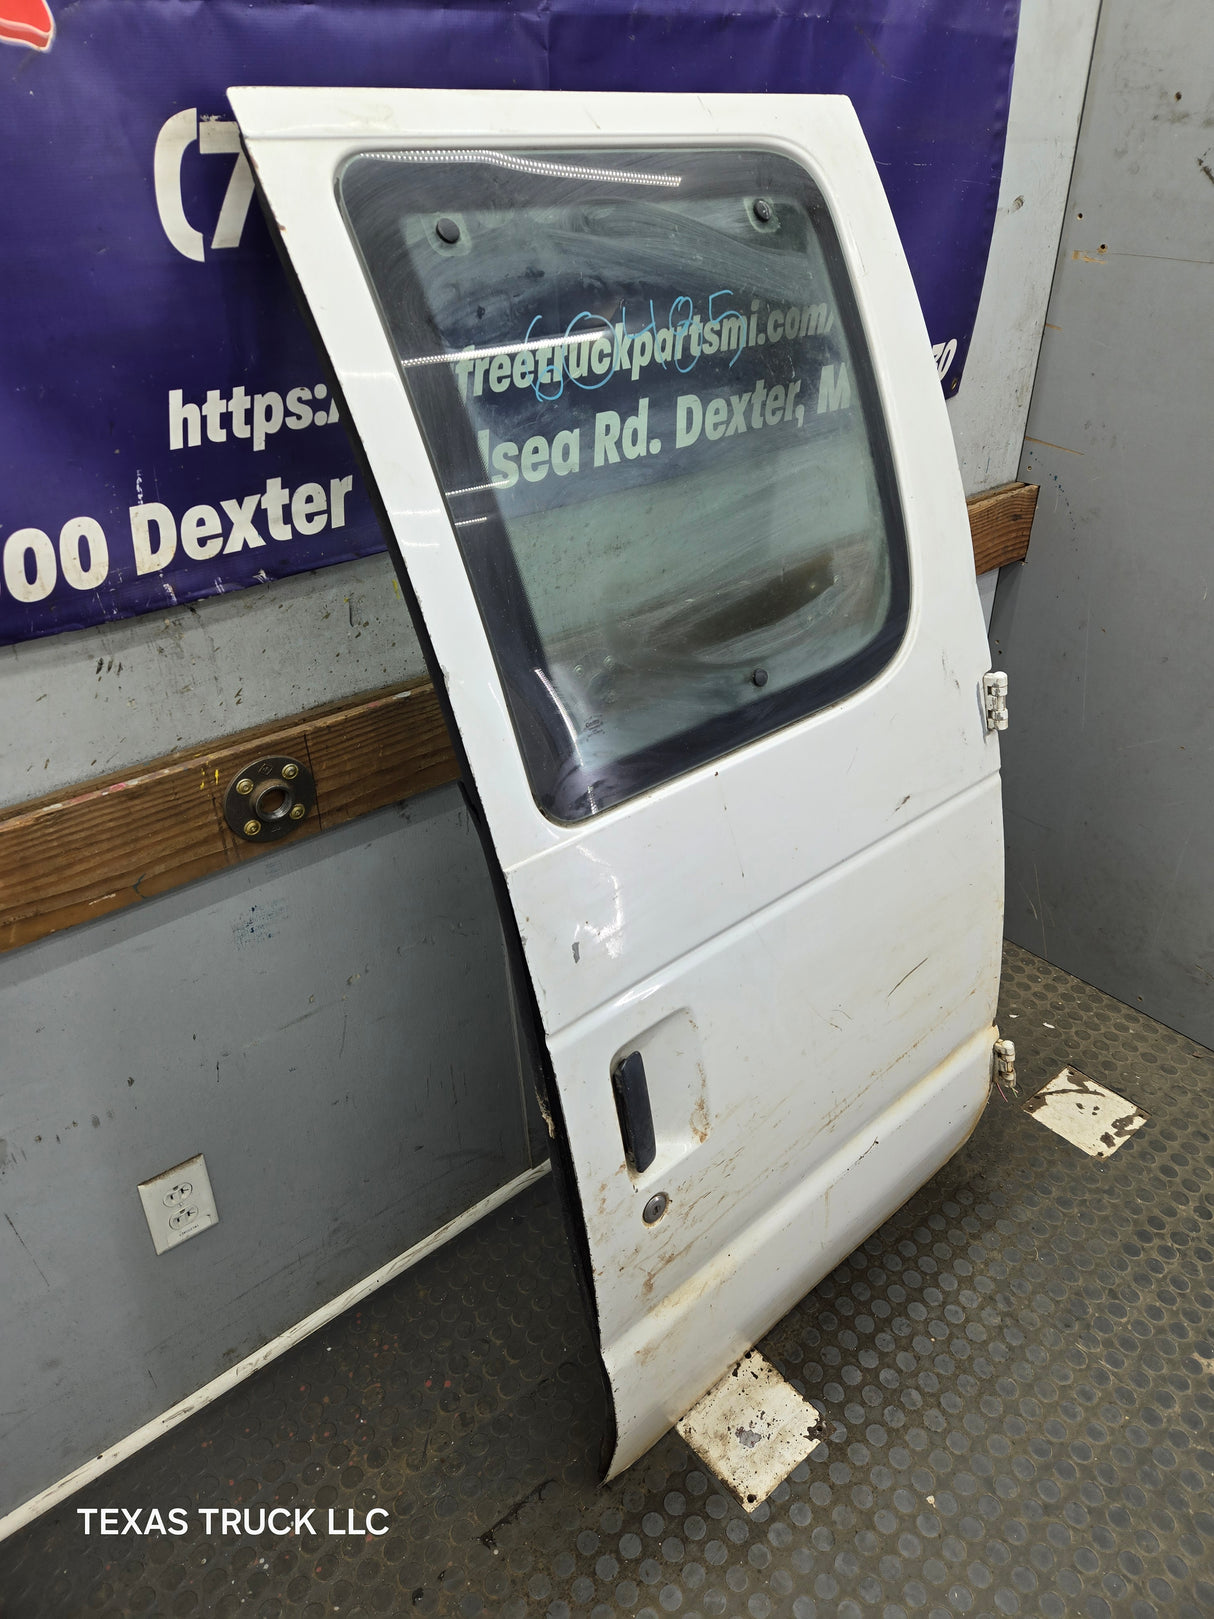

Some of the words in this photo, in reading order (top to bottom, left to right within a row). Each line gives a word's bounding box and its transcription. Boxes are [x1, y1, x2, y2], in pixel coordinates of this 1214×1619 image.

[154, 107, 256, 262] (7
[129, 475, 353, 576] Dexter
[594, 397, 662, 467] Rd.
[676, 379, 805, 448] Dexter,
